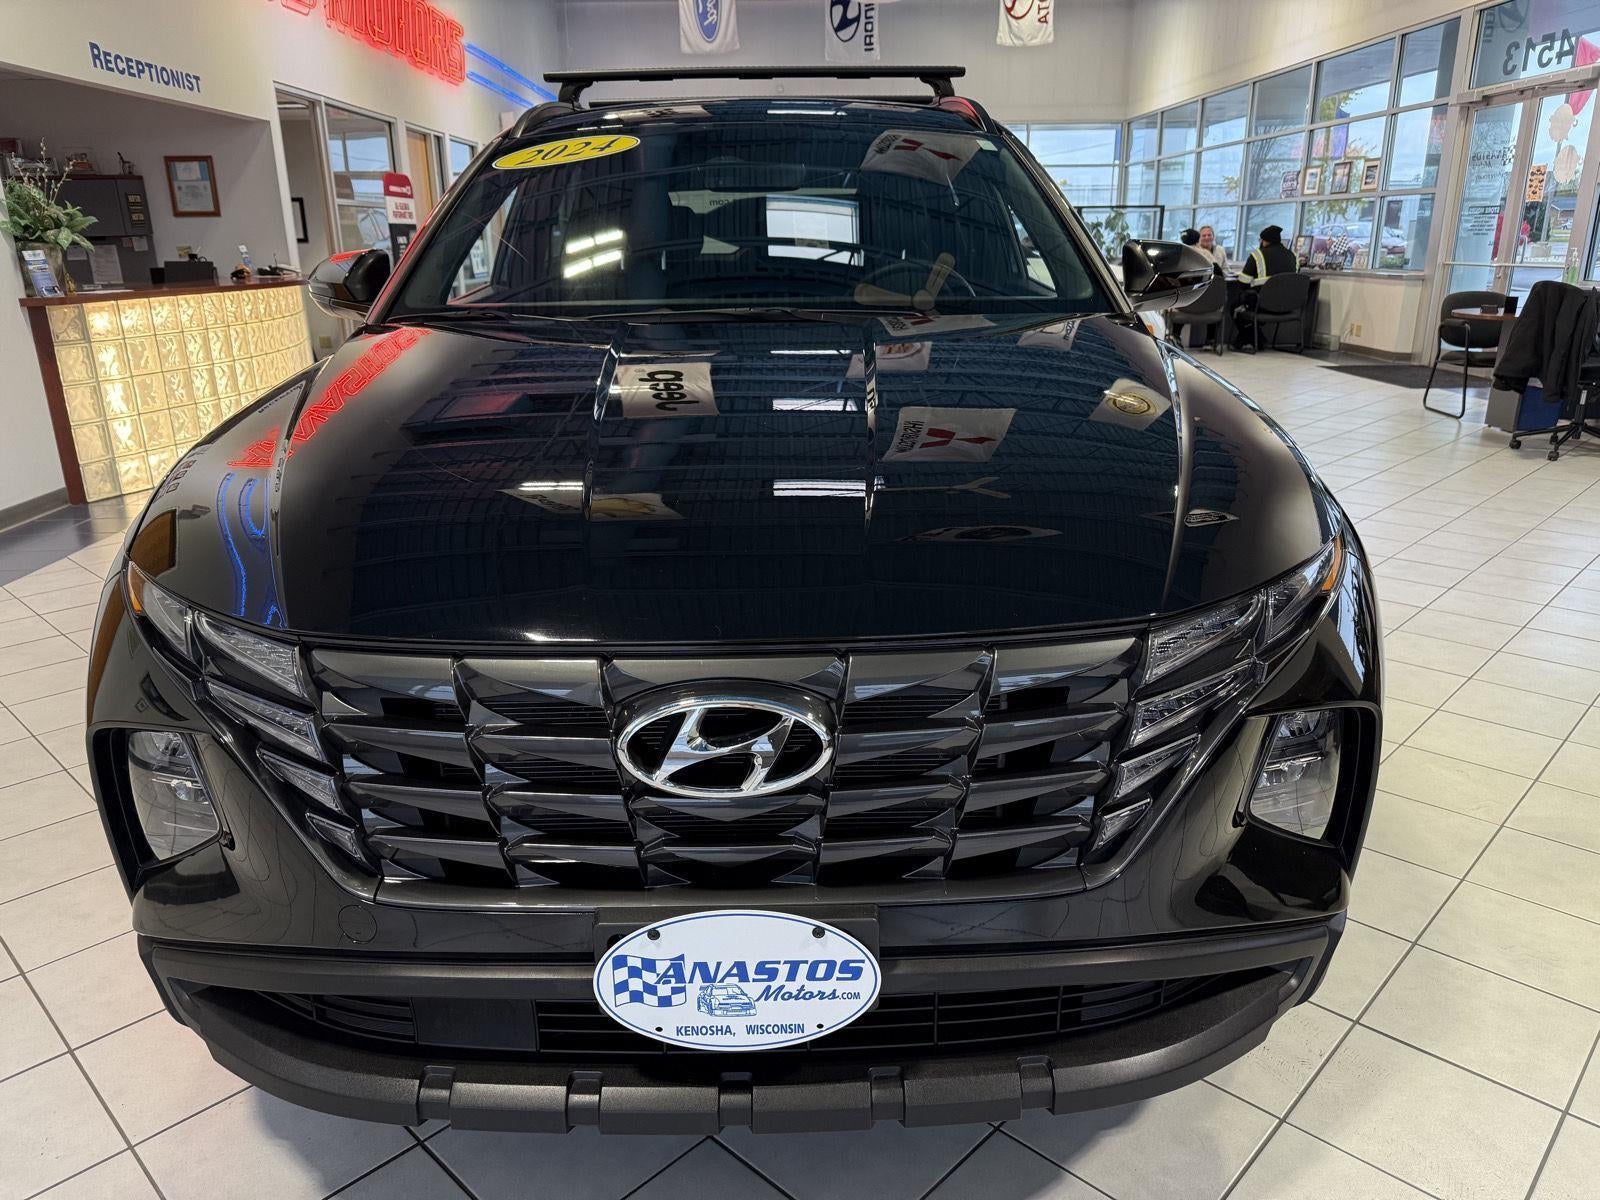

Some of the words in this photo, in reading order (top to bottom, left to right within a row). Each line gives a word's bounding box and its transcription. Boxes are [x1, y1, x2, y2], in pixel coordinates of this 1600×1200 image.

[88, 41, 201, 93] RECEPTIONIST
[515, 136, 622, 166] 2024
[654, 959, 866, 985] ANASTOS
[676, 1024, 737, 1037] KENOSHA,
[745, 1023, 805, 1035] WISCONSIN
